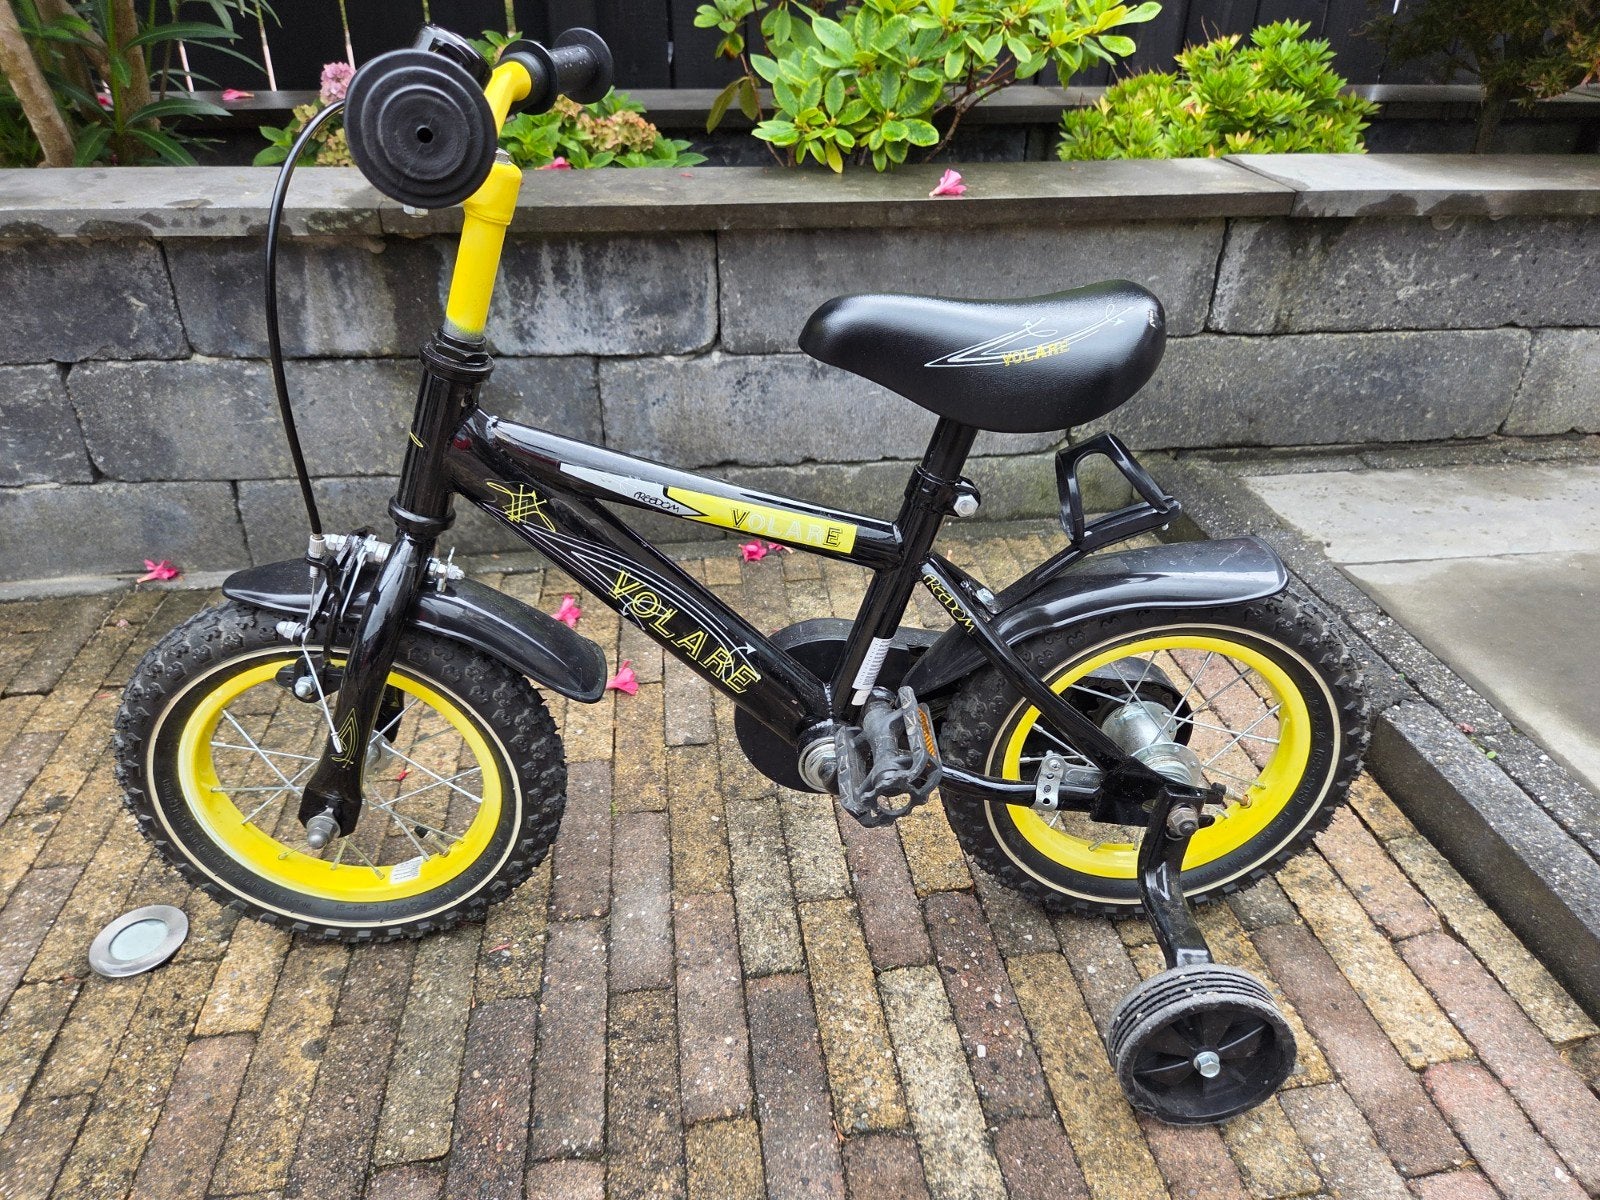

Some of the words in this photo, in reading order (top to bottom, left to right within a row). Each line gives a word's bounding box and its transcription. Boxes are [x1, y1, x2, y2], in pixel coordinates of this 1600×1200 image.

[1002, 339, 1070, 367] VOLARE
[731, 508, 843, 548] VOLARE
[608, 568, 761, 694] VOLARE
